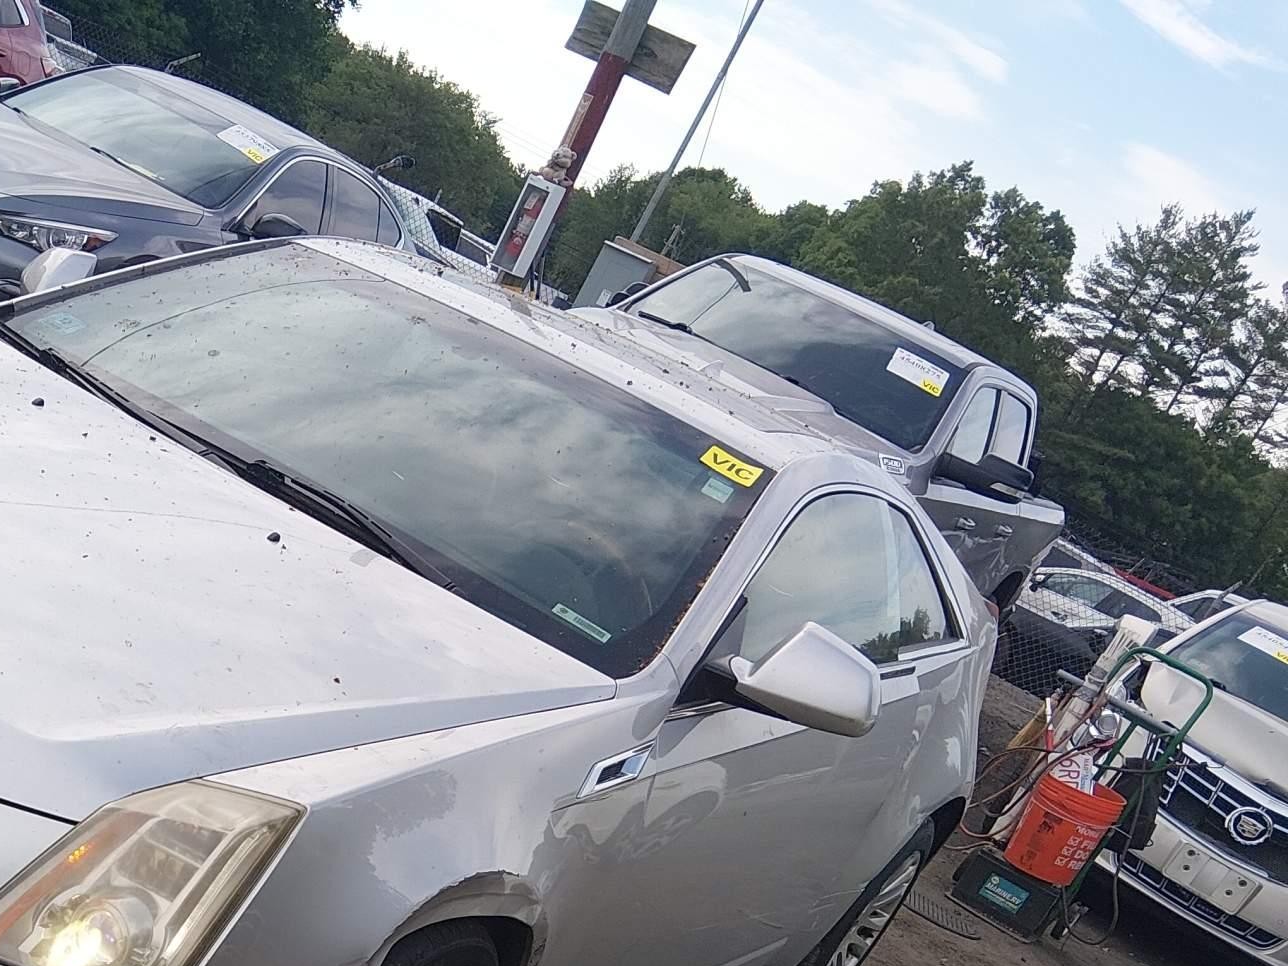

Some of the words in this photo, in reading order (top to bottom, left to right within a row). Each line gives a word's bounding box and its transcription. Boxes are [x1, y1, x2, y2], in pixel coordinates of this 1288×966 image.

[923, 380, 940, 394] VIC
[713, 452, 754, 480] VIC
[1277, 651, 1288, 662] VI
